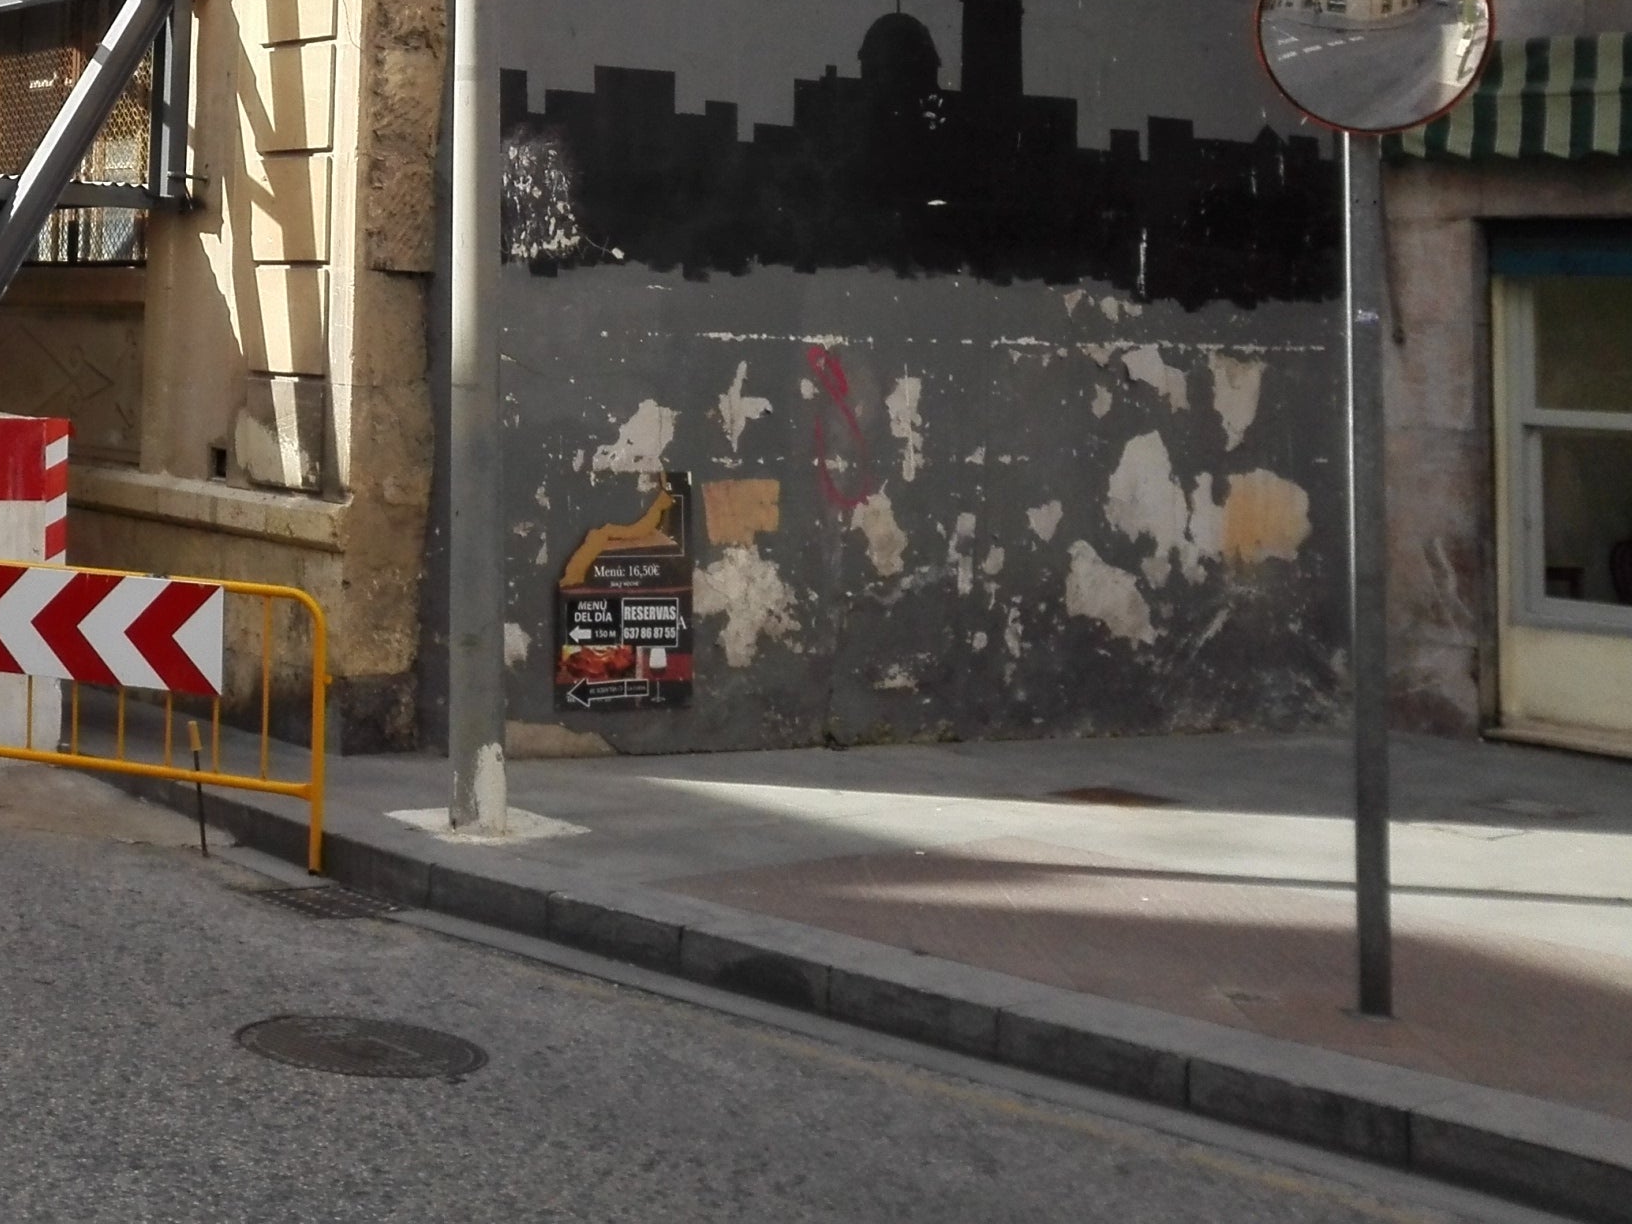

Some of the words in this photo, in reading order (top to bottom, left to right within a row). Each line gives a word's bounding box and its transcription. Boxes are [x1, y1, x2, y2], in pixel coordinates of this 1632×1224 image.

[574, 612, 593, 622] DEL
[624, 605, 676, 621] RESERVAS
[608, 630, 617, 638] M
[623, 627, 640, 639] 637
[640, 627, 652, 639] 86
[653, 627, 664, 639] 87
[664, 627, 676, 638] 55
